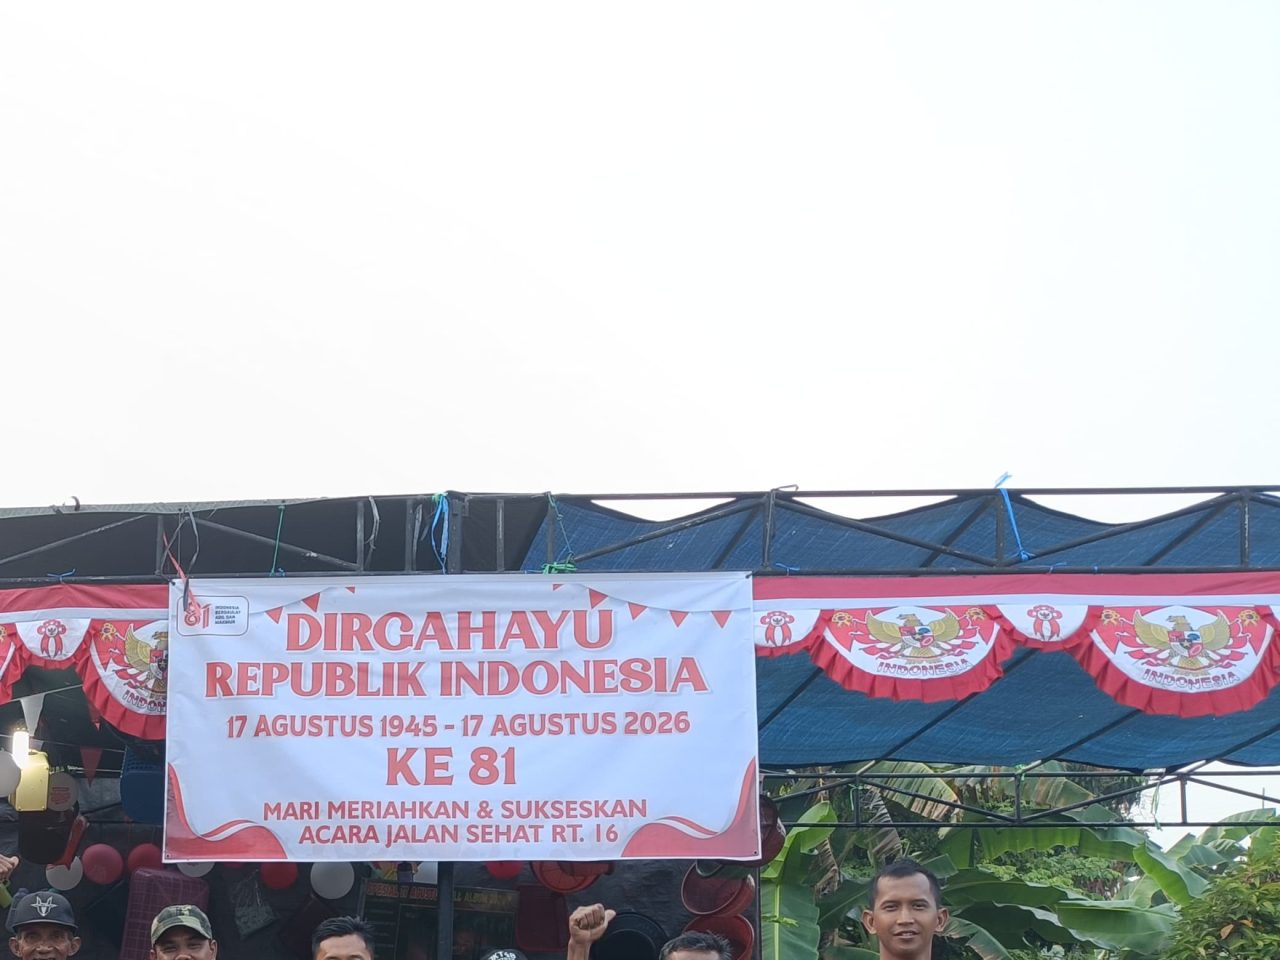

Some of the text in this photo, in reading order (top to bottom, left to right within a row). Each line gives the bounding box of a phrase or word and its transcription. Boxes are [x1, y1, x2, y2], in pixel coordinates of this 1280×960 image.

[286, 610, 613, 651] DIRGAHAYU
[205, 657, 709, 698] REPUBLIK INDONESIA
[876, 658, 974, 677] INDONESIA
[1142, 668, 1241, 690] INDONESIA
[122, 690, 167, 714] INDON
[227, 715, 248, 738] 17
[254, 714, 374, 738] AGUSTUS
[380, 714, 438, 737] 1945
[462, 714, 484, 737] 17
[490, 711, 618, 737] AGUSTUS
[624, 711, 691, 736] 2026
[386, 746, 517, 786] KE 81
[263, 799, 648, 821] MARI MERIAHKAN & SUKSESKAN
[299, 823, 619, 849] ACARA JALAN SEHAT RT. 16
